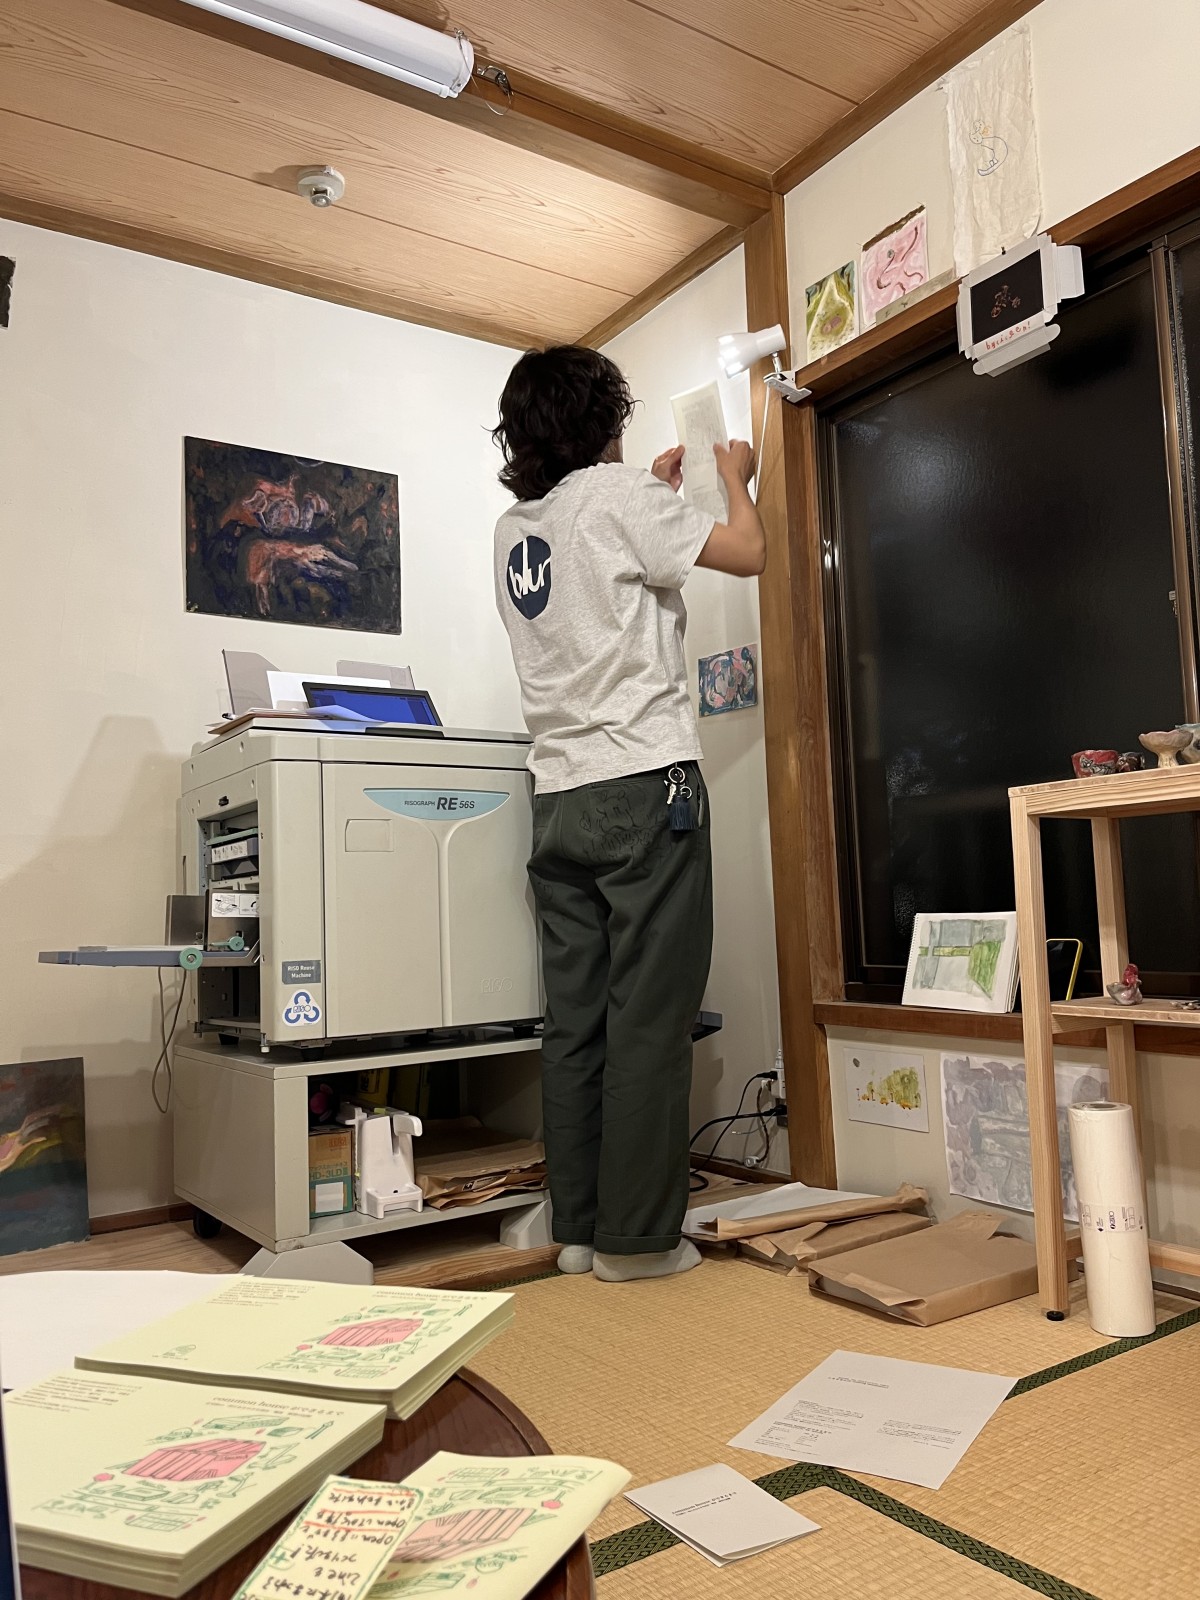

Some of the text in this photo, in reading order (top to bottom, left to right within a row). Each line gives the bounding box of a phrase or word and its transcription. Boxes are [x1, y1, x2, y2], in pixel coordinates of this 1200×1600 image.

[508, 537, 550, 599] blur
[436, 797, 458, 810] RE
[459, 800, 475, 809] 56S
[293, 1005, 311, 1013] RISO
